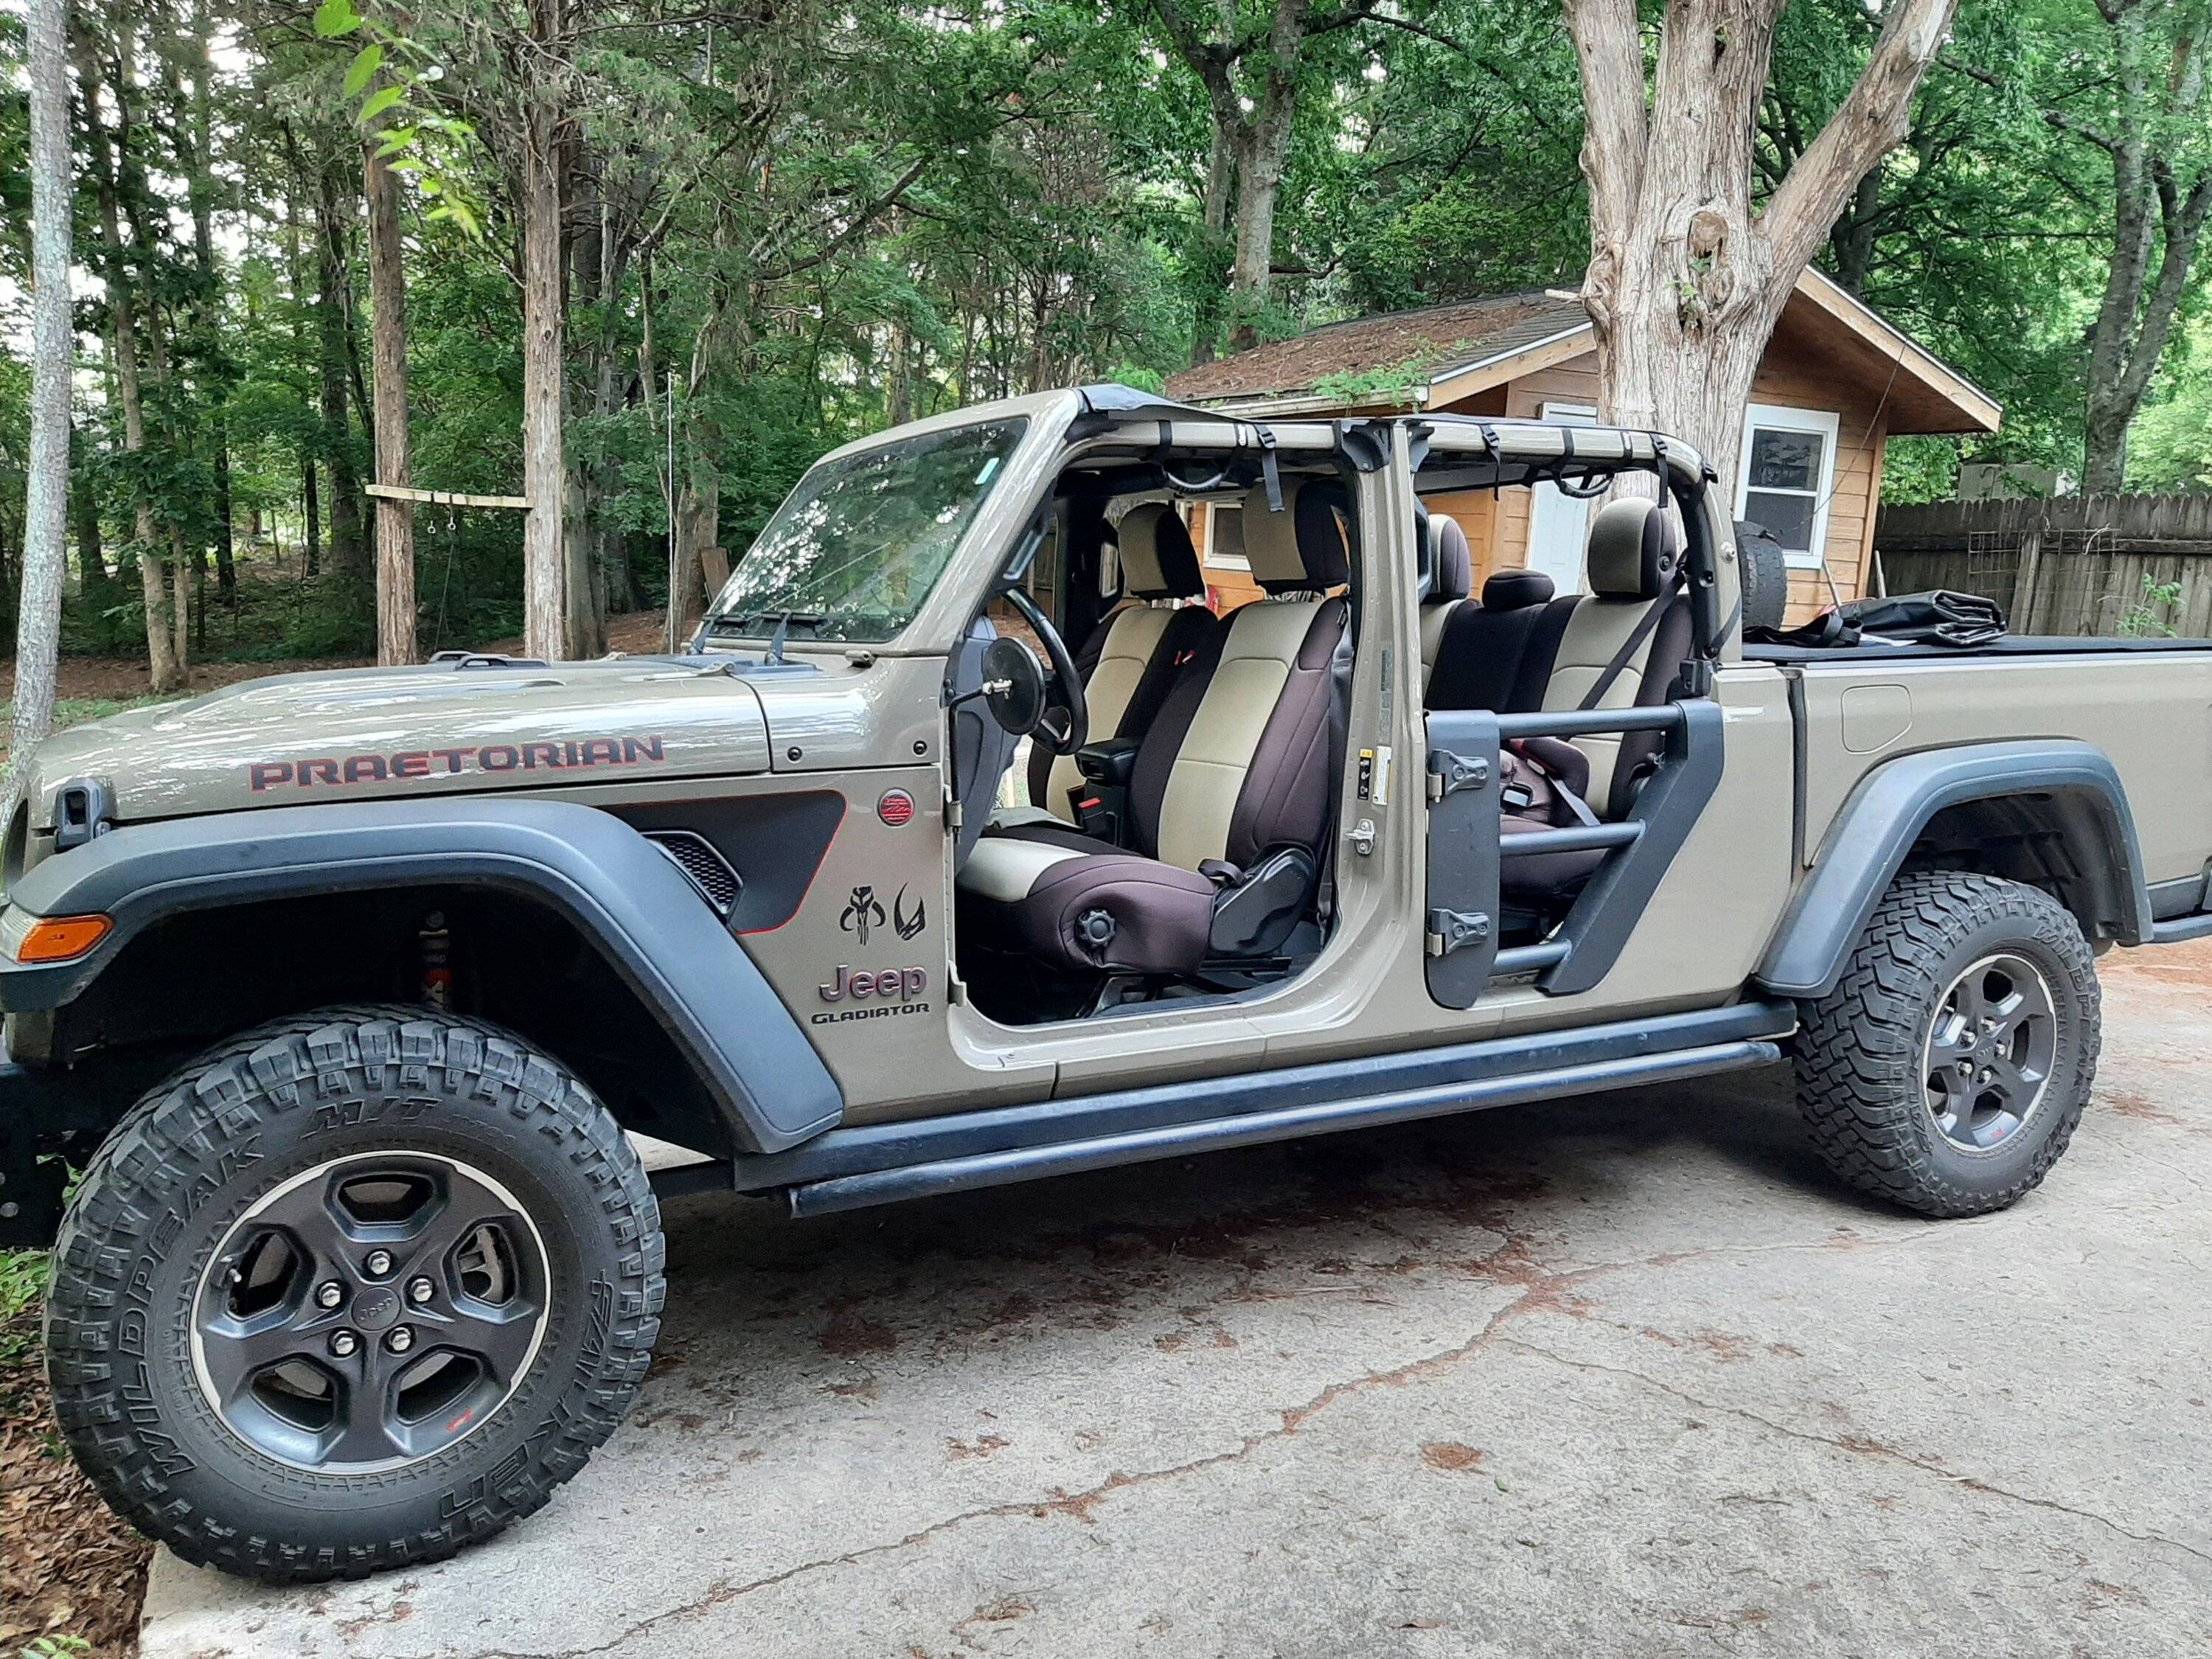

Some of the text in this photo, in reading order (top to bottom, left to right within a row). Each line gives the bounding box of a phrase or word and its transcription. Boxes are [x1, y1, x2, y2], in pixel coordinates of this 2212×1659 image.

[250, 735, 664, 793] PRAETORIAN
[819, 964, 928, 1002] Jeep
[811, 1003, 930, 1025] GLADIATOR
[118, 1096, 442, 1477] WILDPEAK M/T
